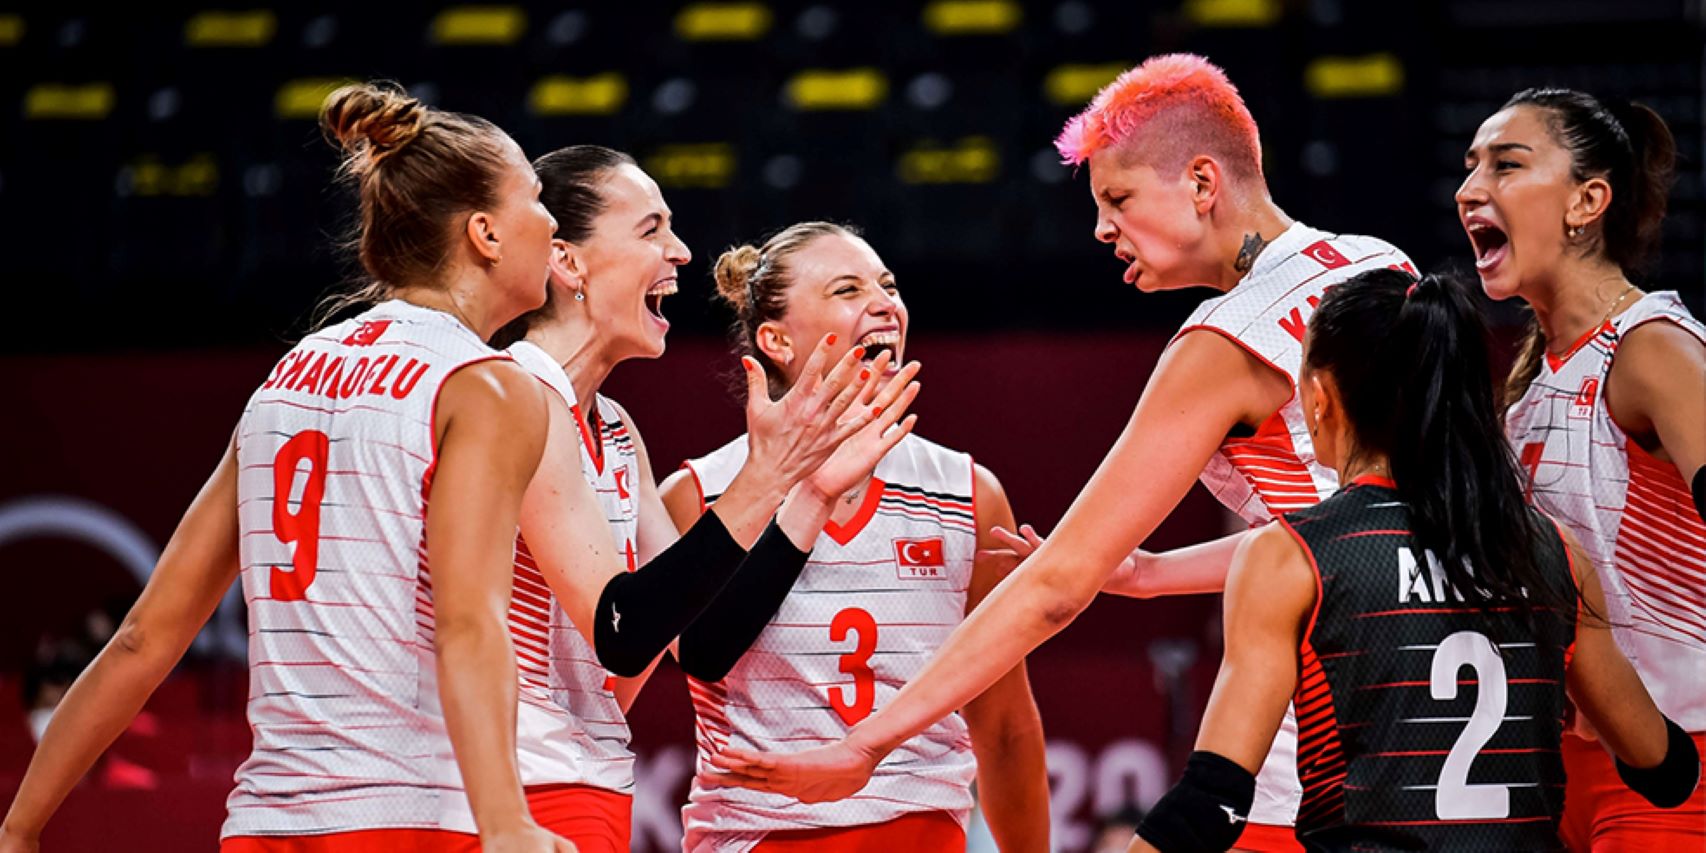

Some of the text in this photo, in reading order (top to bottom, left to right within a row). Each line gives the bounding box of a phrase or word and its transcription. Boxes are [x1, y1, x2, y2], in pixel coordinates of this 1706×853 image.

[269, 429, 330, 602] 9
[909, 567, 939, 576] TUR
[827, 607, 879, 727] 3
[1430, 630, 1510, 820] 2
